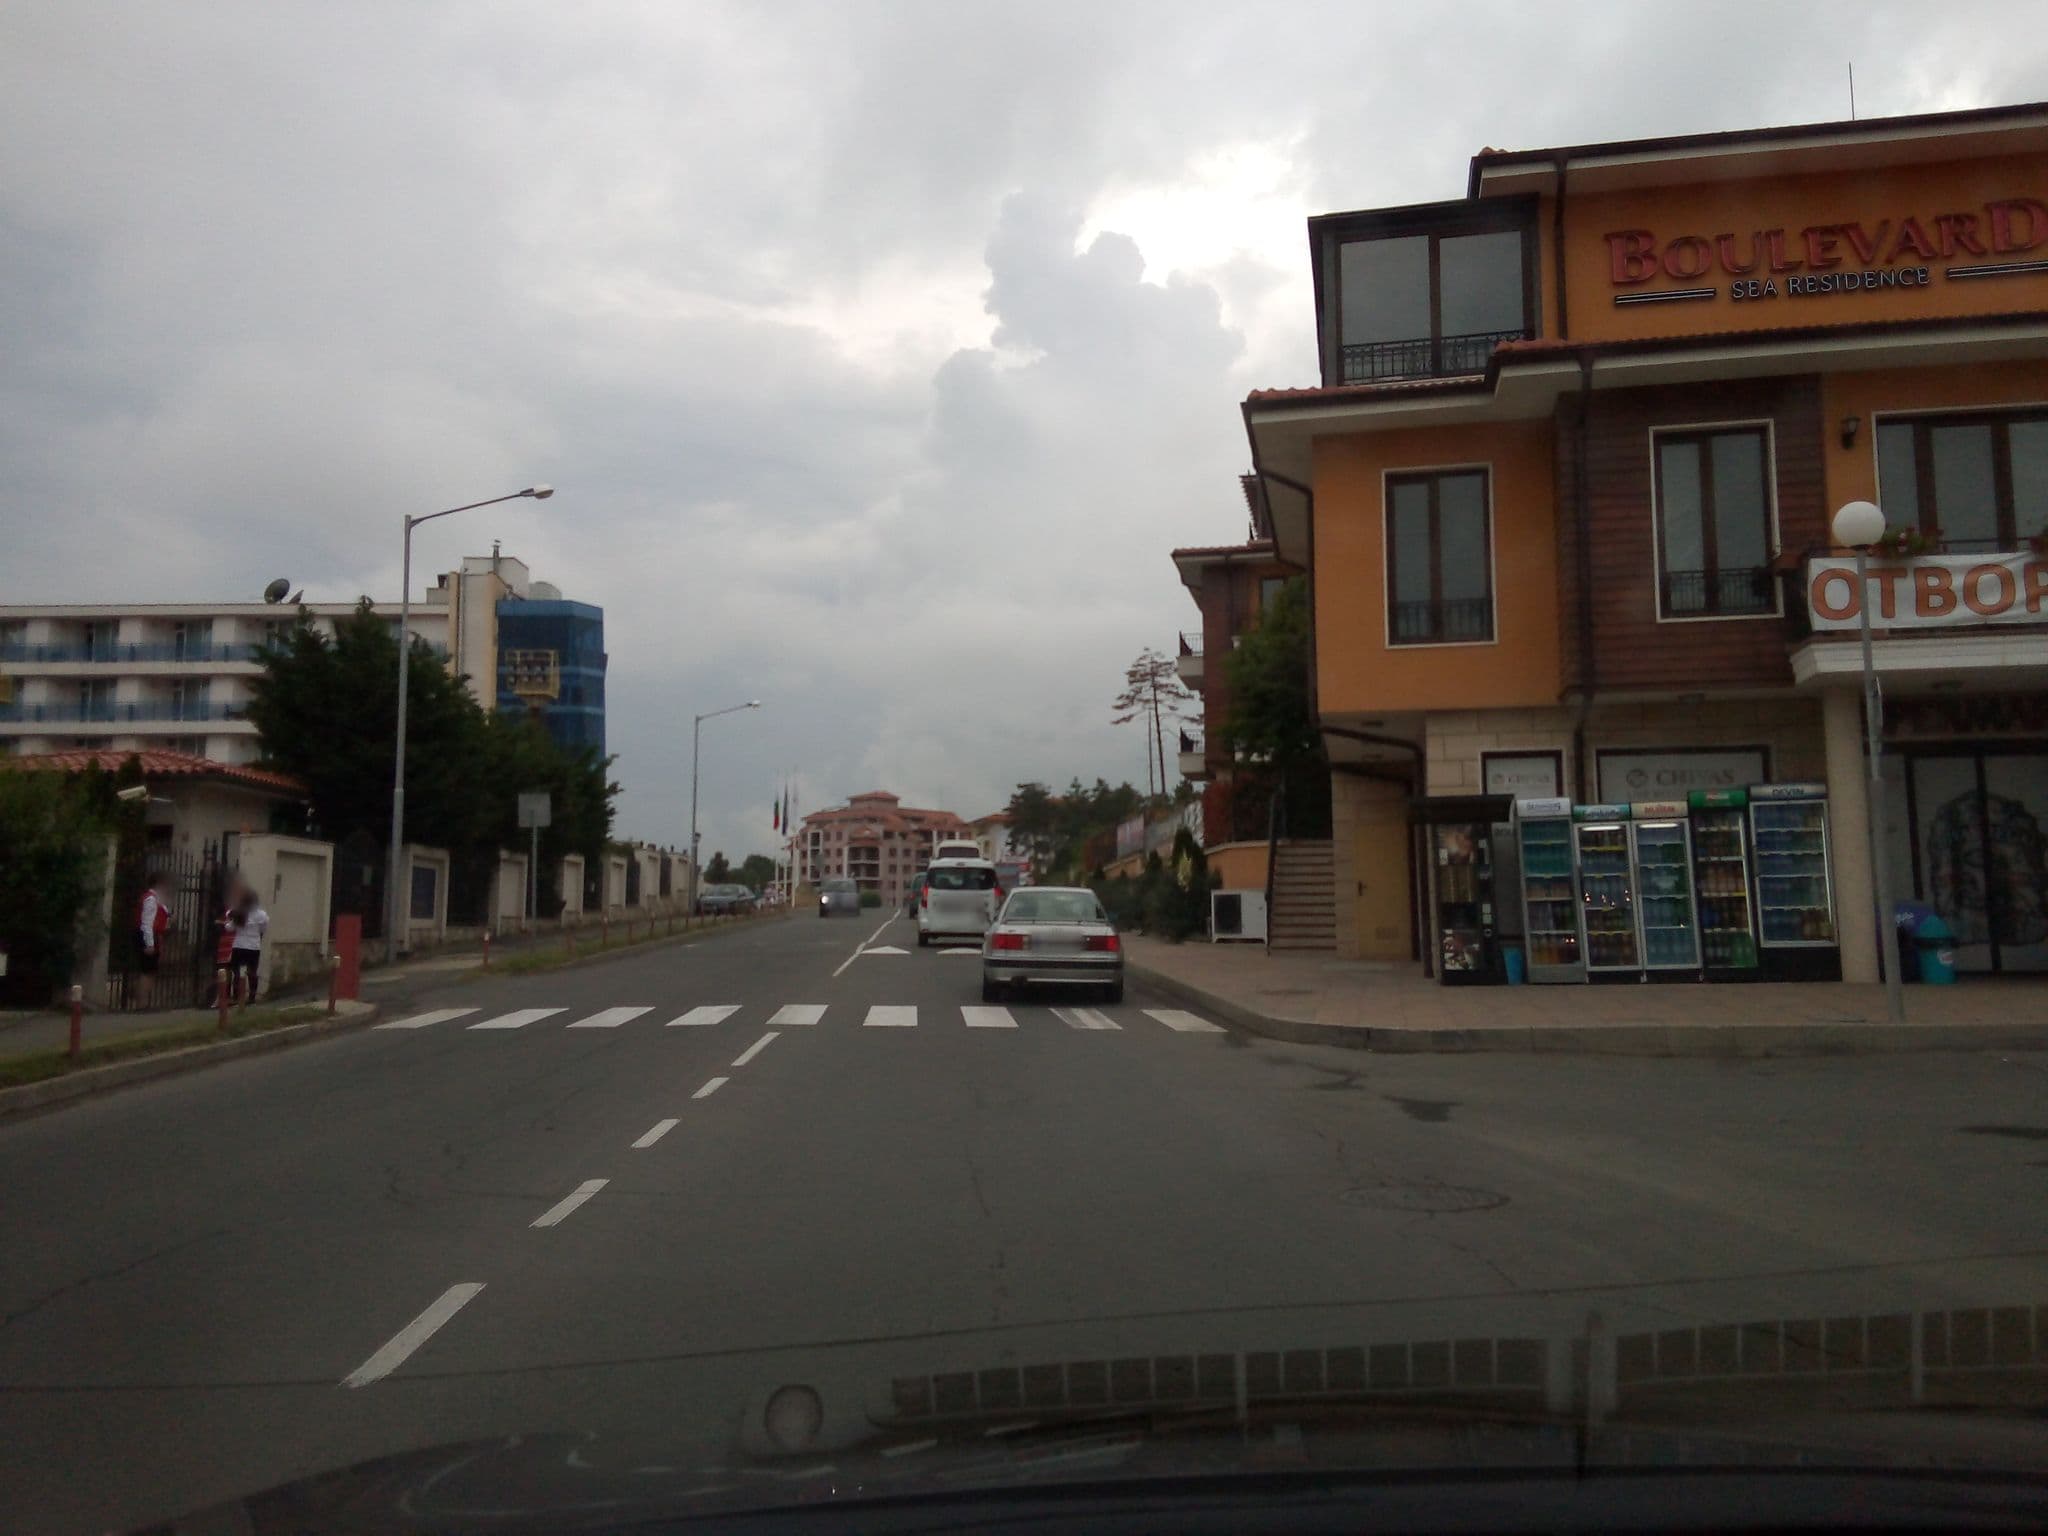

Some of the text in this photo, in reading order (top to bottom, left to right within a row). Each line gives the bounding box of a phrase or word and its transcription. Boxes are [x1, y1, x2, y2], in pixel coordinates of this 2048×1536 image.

[1605, 198, 2048, 285] BOULEVARD
[1732, 268, 1930, 299] SEA RESIDENCE
